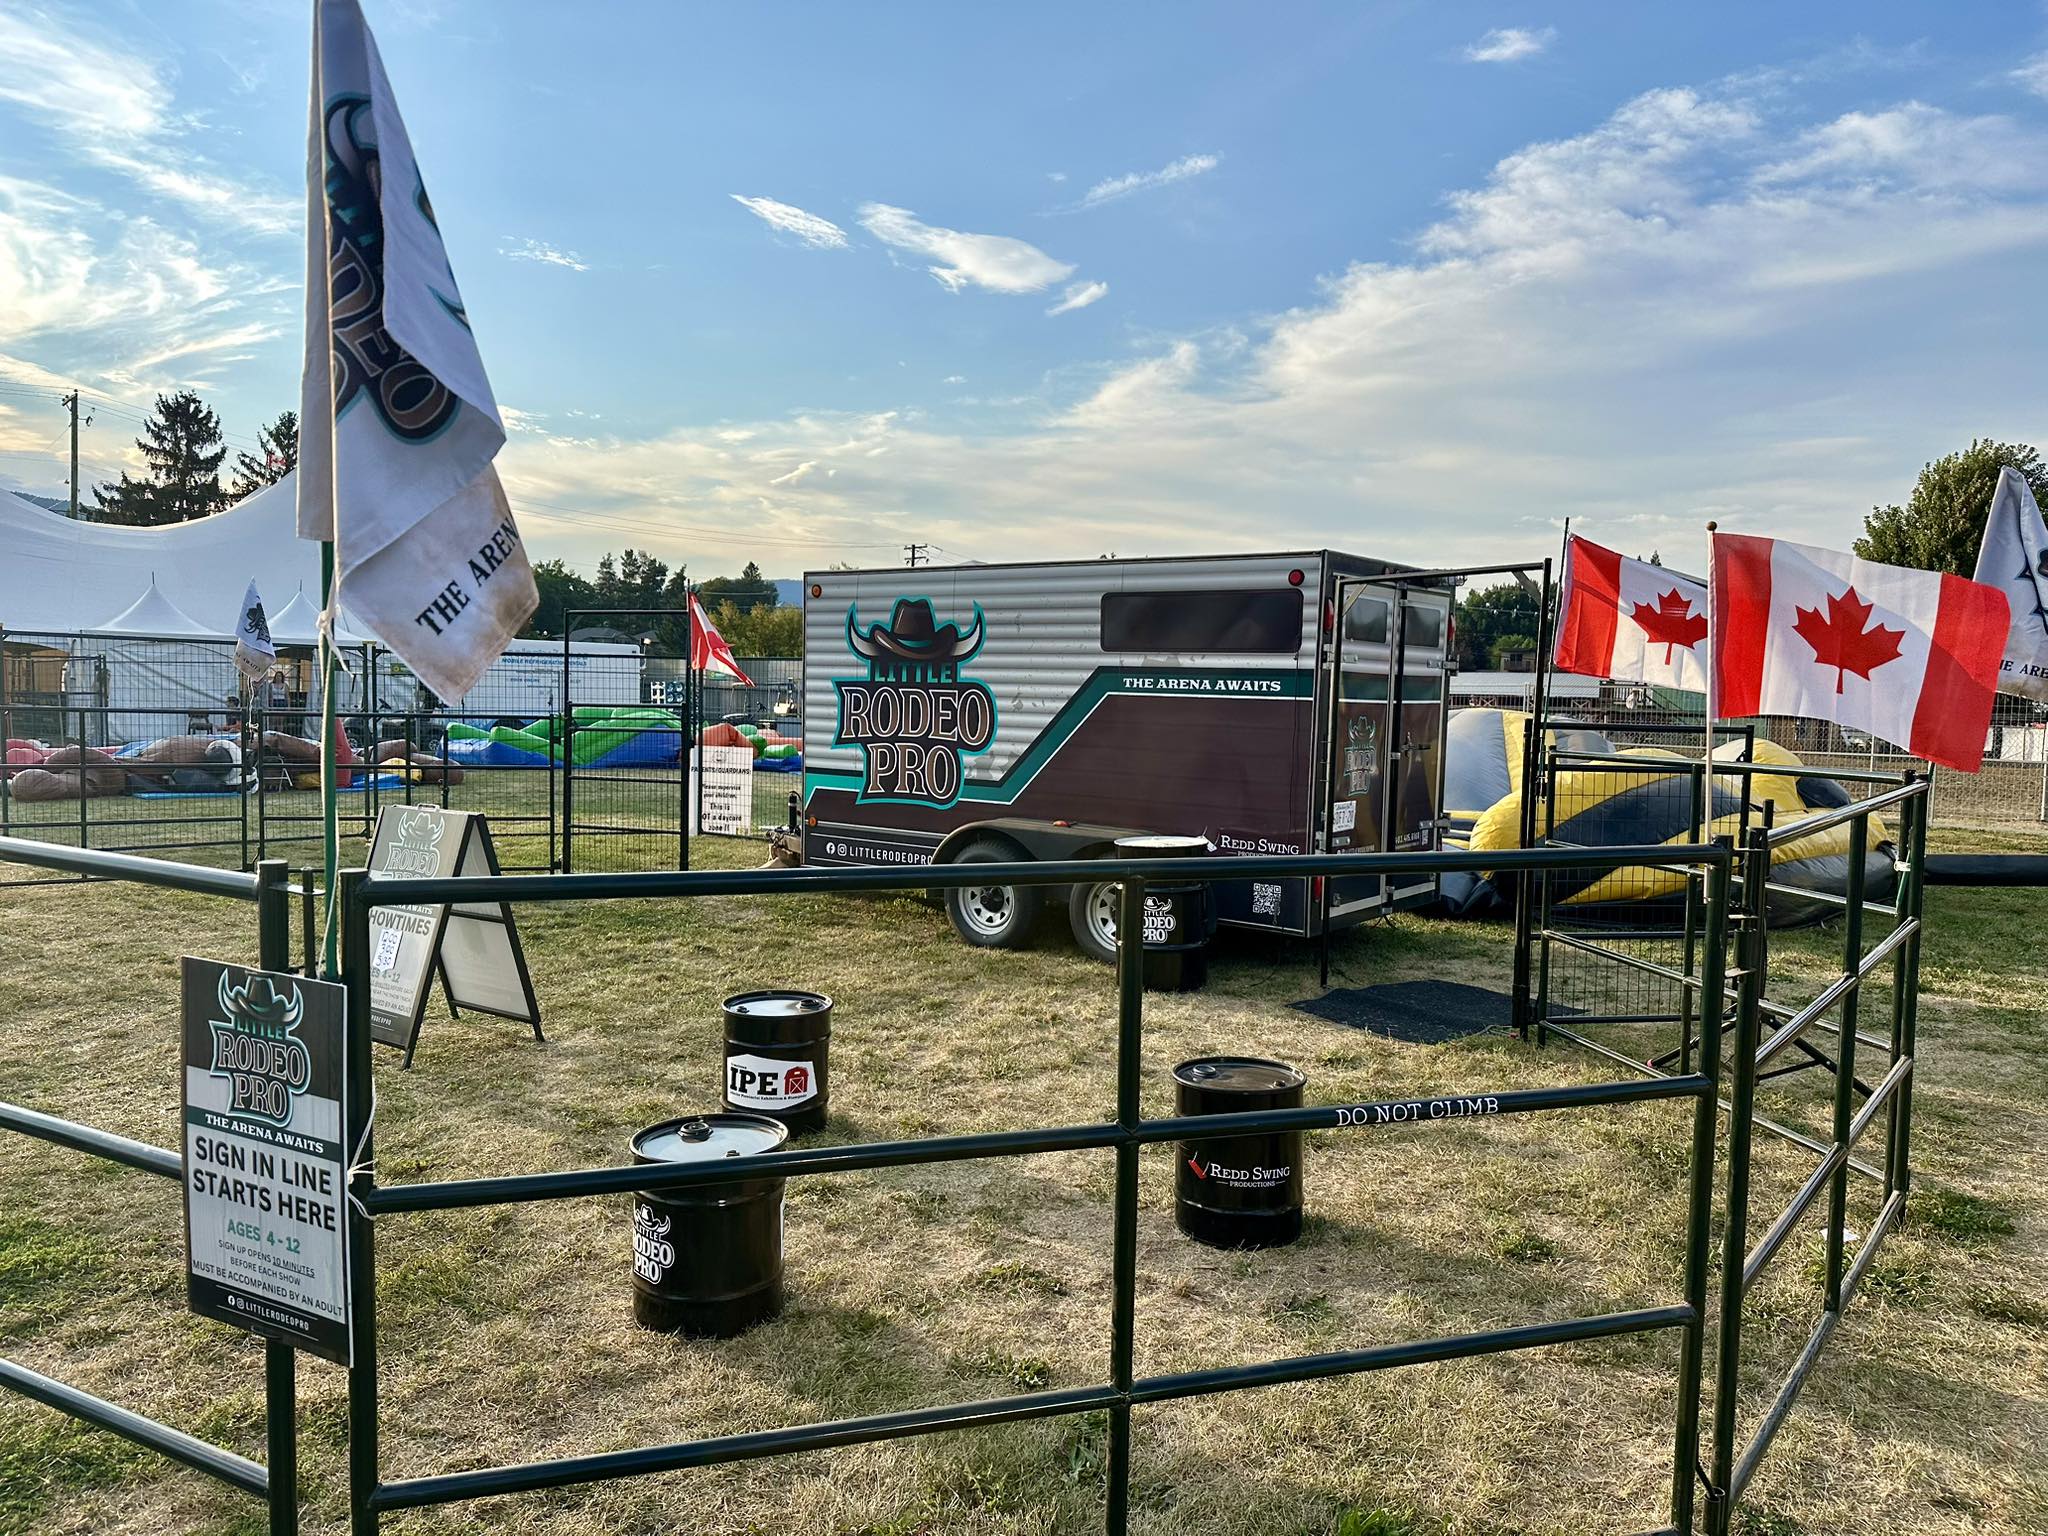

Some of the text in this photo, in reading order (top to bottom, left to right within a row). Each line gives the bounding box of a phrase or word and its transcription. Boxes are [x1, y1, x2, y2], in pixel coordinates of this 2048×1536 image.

[414, 579, 471, 636] THE
[874, 662, 953, 683] LITTLE
[1123, 678, 1281, 692] THE ARENA AWAITS
[841, 686, 990, 746] RODEO
[867, 743, 956, 799] PRO
[1220, 834, 1299, 855] REDD SWING
[387, 847, 437, 876] RODEO
[369, 909, 432, 936] HOWTIMES
[236, 1018, 284, 1040] LITTLE
[217, 1030, 306, 1086] RODEO
[233, 1072, 288, 1119] PRO
[730, 1066, 778, 1096] IPE
[1336, 1097, 1499, 1127] DO NOT CLIMB
[205, 1113, 324, 1154] THE ARENA AWAITS
[195, 1135, 332, 1196] SIGN IN LINE
[1210, 1162, 1290, 1180] REDD SWING
[1229, 1180, 1276, 1188] PRODUCTIONS
[193, 1167, 336, 1232] STARTS HERE
[227, 1218, 262, 1242] AGES
[218, 1239, 316, 1278] SIGN UP OPENS 10 MINUTES
[230, 1256, 301, 1286] BEFORE EACH SHOW
[634, 1250, 660, 1281] PRO
[192, 1260, 343, 1317] MUST BE ACCOMPANIED BY AN ADULT
[245, 1300, 310, 1331] LITTLERODEOPRO
